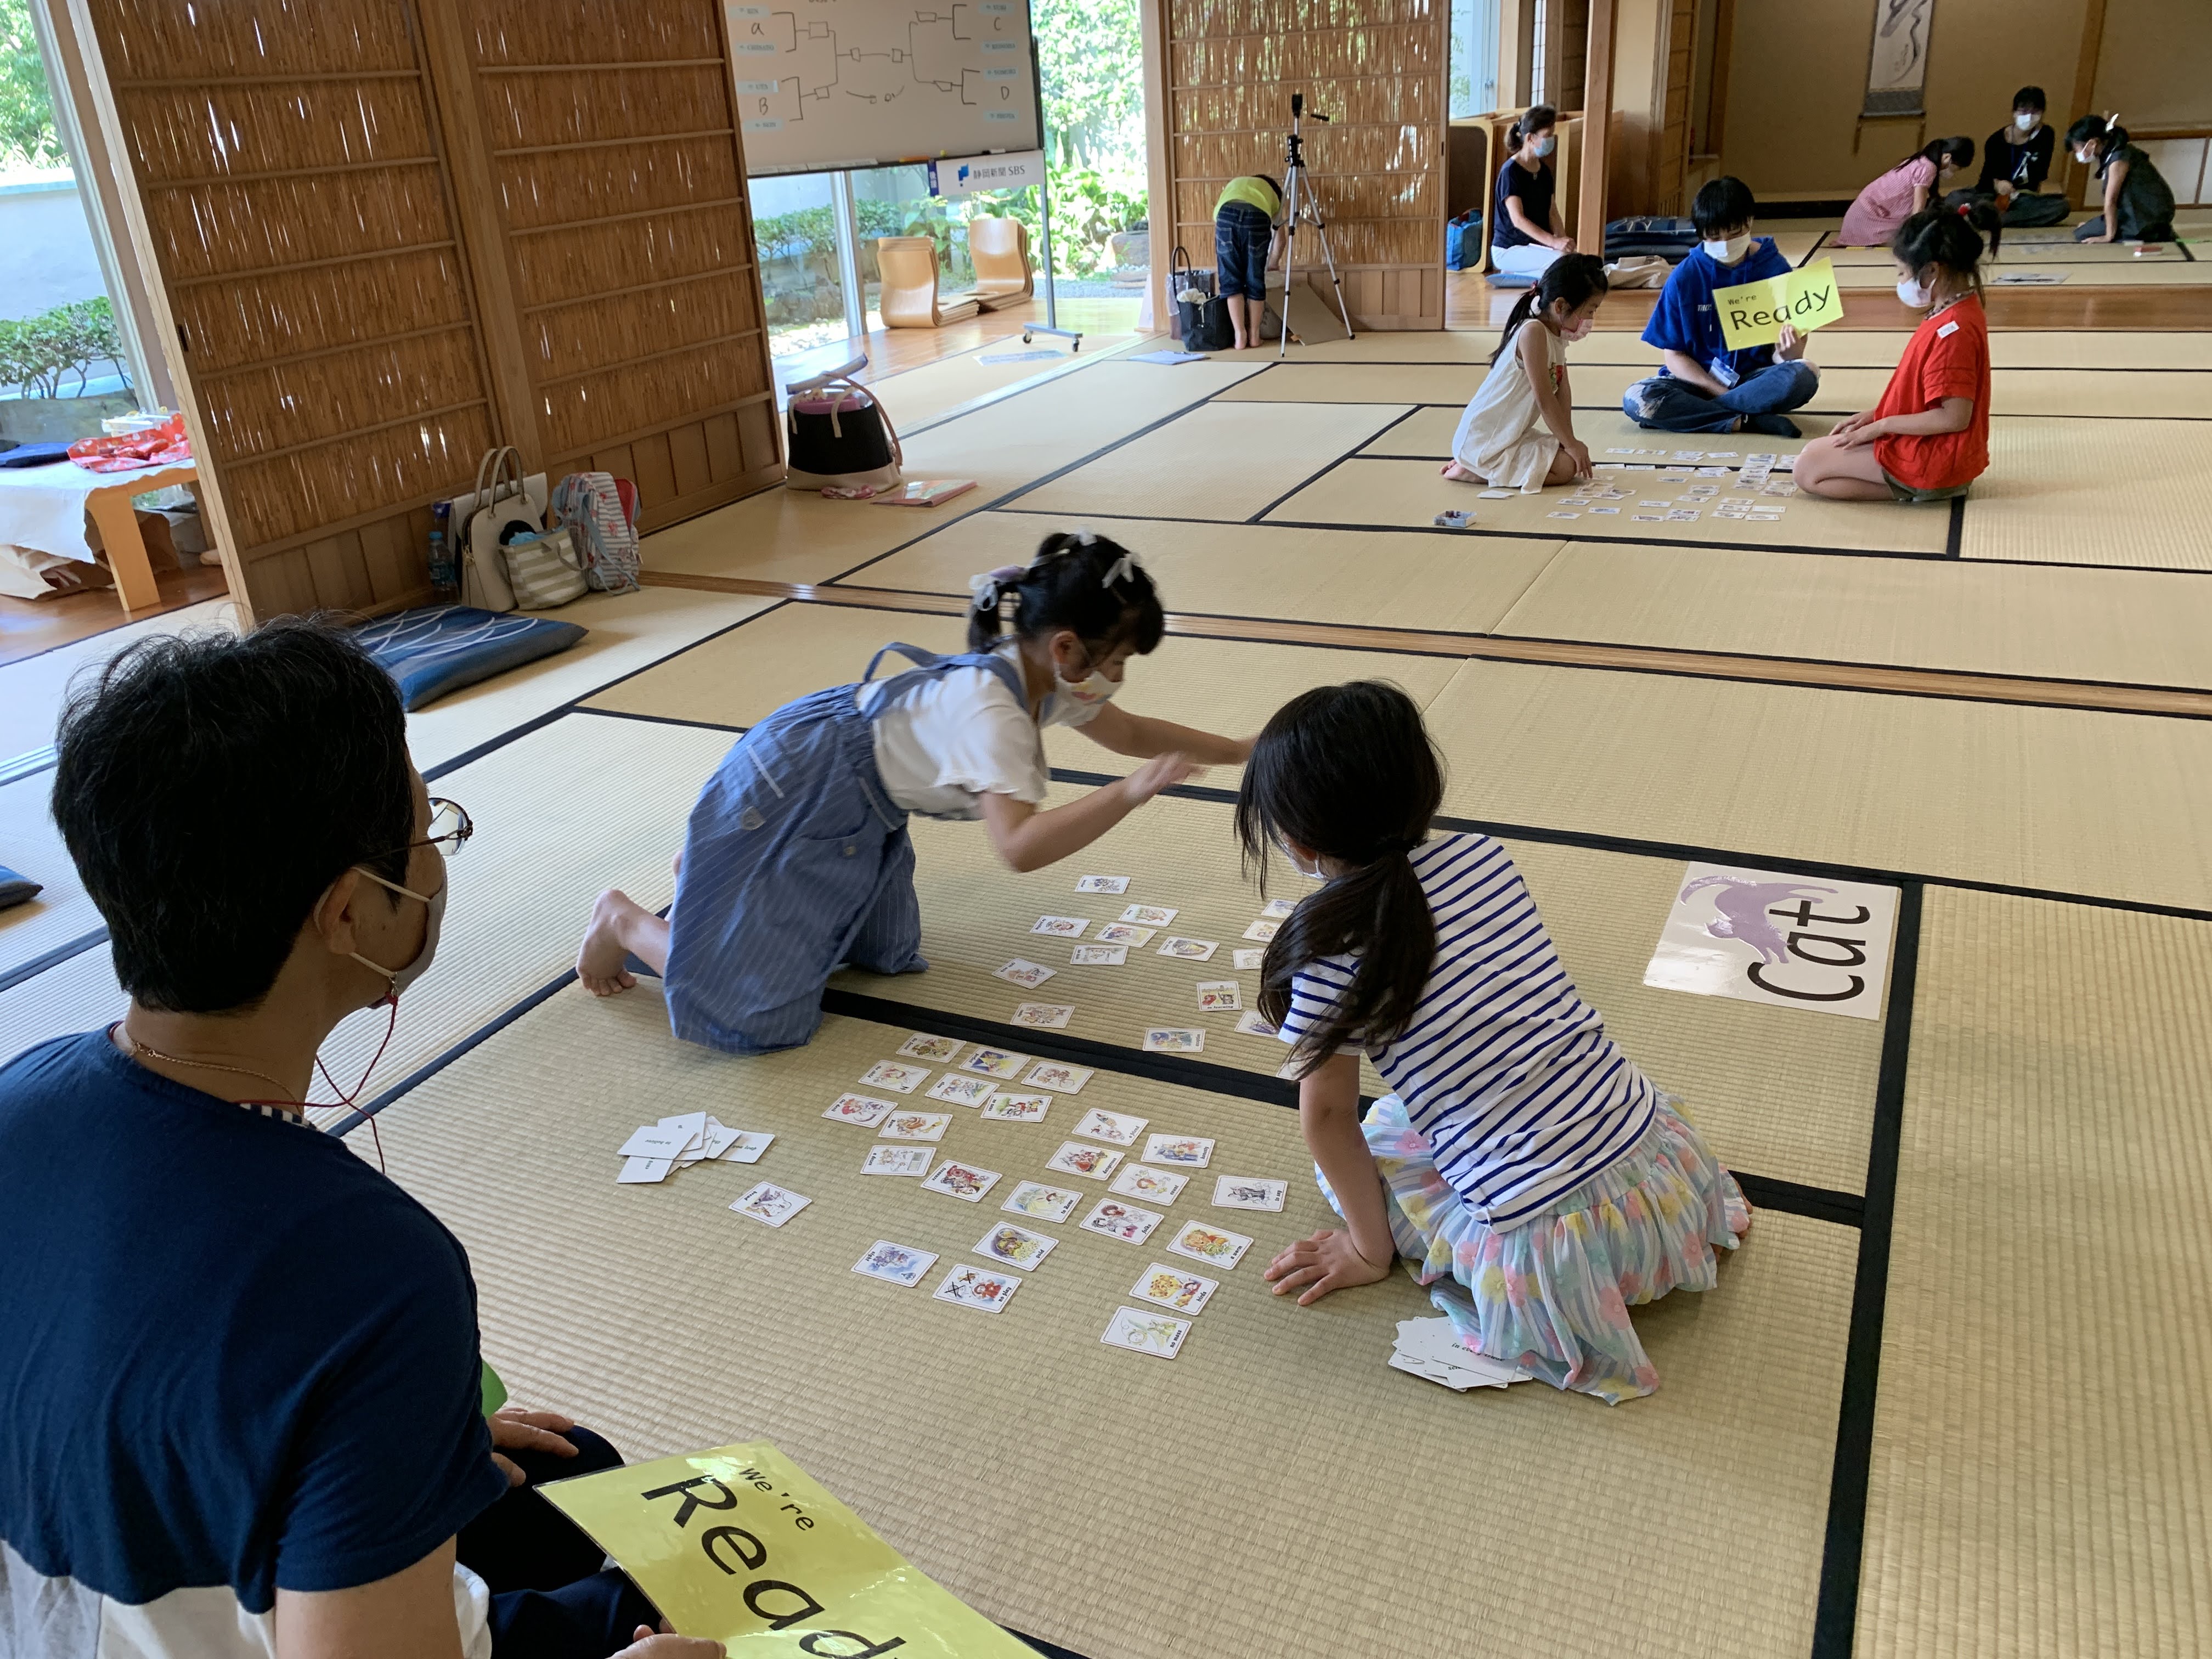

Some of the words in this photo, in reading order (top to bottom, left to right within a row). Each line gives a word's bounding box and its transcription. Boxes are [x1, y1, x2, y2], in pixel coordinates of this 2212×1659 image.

[1001, 86, 1010, 100] D
[759, 97, 768, 115] B
[1008, 165, 1025, 176] SBS
[1728, 294, 1757, 306] We're
[1730, 285, 1830, 330] Ready
[1747, 900, 1870, 1002] Cat
[1131, 1126, 1140, 1137] friend
[1200, 1147, 1210, 1159] honesty
[1103, 1158, 1117, 1174] dangerous
[933, 1167, 946, 1181] treasure
[744, 1190, 758, 1201] bread
[1064, 1199, 1074, 1210] Rome
[1141, 1224, 1152, 1234] folks
[865, 1251, 875, 1261] sight
[1035, 1249, 1045, 1259] gold
[1233, 1246, 1242, 1256] worm
[1002, 1286, 1012, 1296] play
[1196, 1291, 1207, 1302] birds
[1173, 1330, 1182, 1341] moss
[739, 1467, 815, 1531] We're
[641, 1475, 908, 1659] Read
